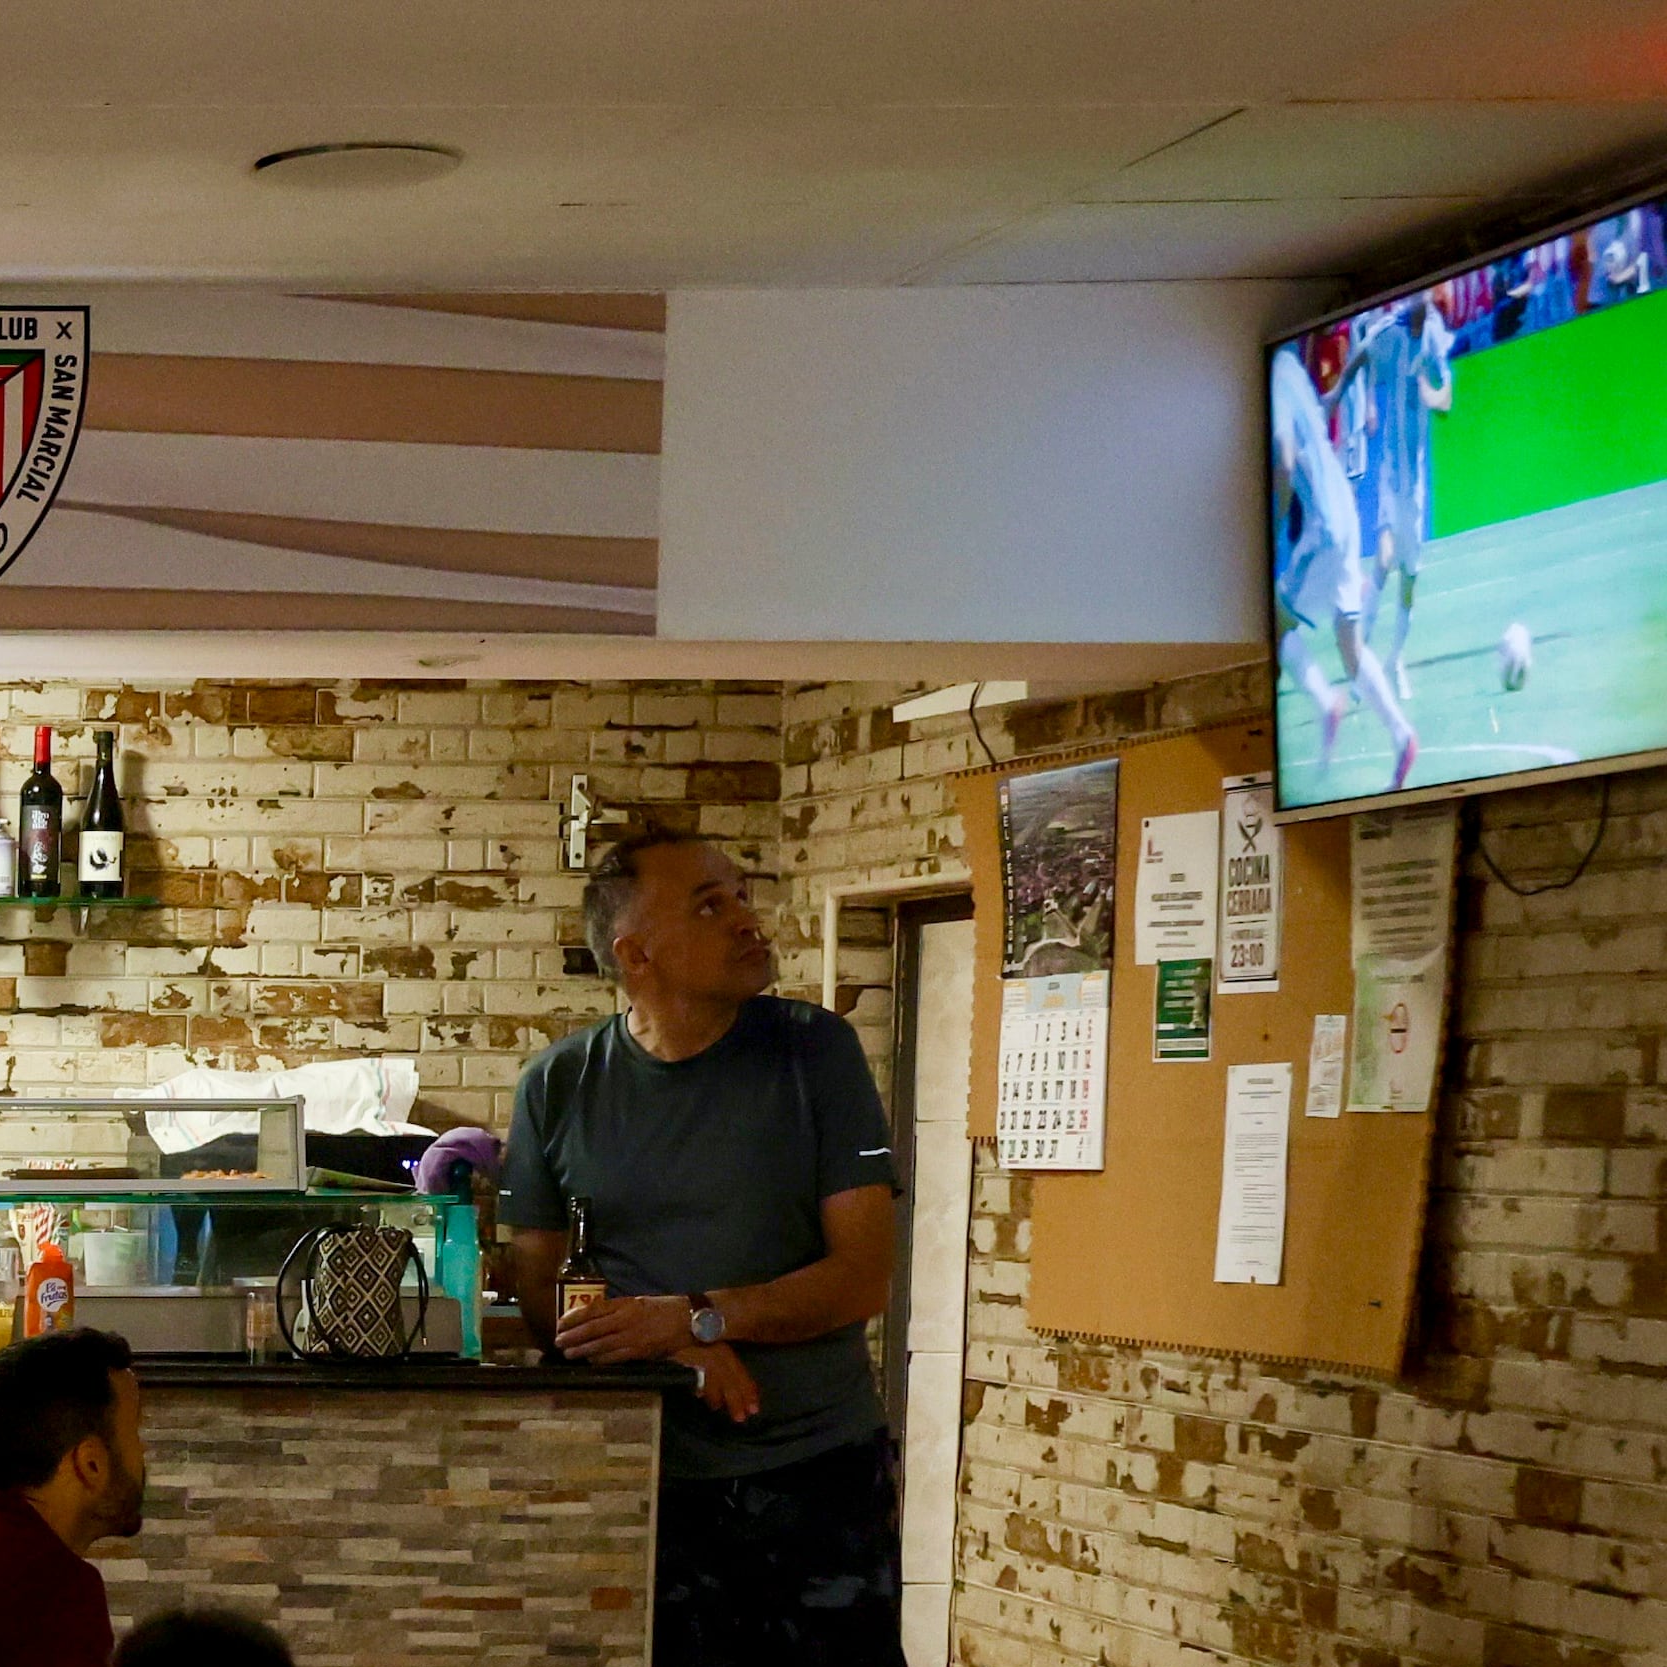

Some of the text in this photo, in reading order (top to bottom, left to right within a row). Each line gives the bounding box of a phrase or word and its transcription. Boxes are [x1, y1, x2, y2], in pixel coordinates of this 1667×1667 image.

[15, 354, 78, 503] SAN MARCIAL
[1228, 854, 1271, 887] COCINA
[1227, 887, 1272, 917] CERRADA
